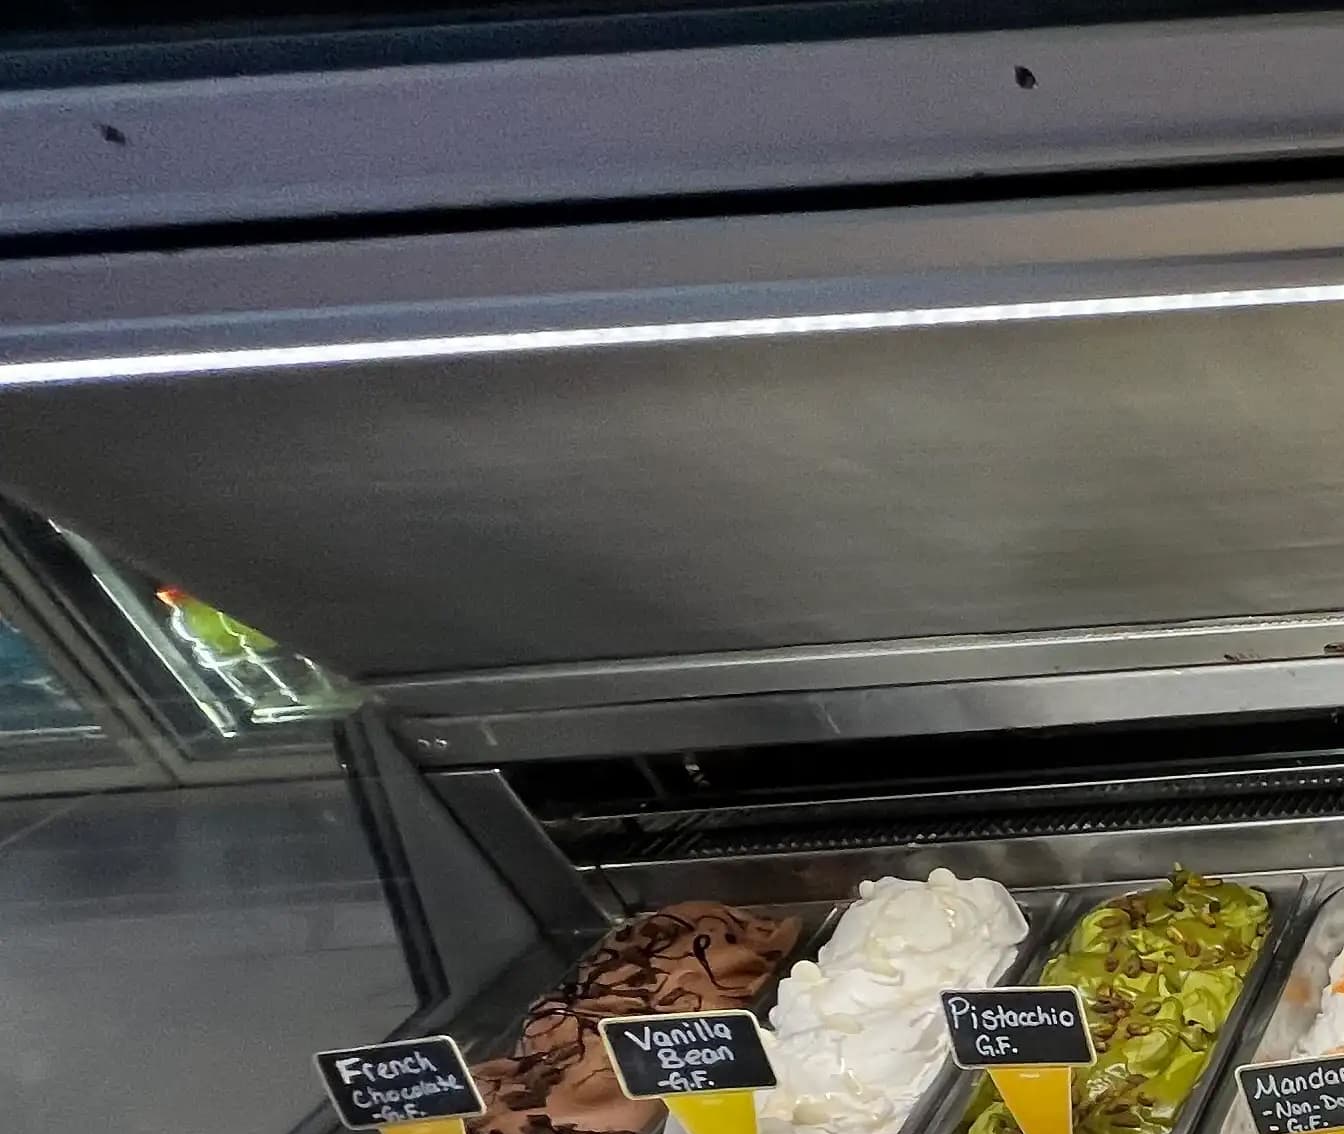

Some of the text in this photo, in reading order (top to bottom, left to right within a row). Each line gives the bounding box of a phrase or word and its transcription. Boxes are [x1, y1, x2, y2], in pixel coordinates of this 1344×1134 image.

[948, 996, 1075, 1031] Pistacchio
[624, 1018, 733, 1051] Vanilla
[976, 1034, 1019, 1057] G.F.
[335, 1051, 438, 1084] French
[657, 1045, 735, 1070] Bean
